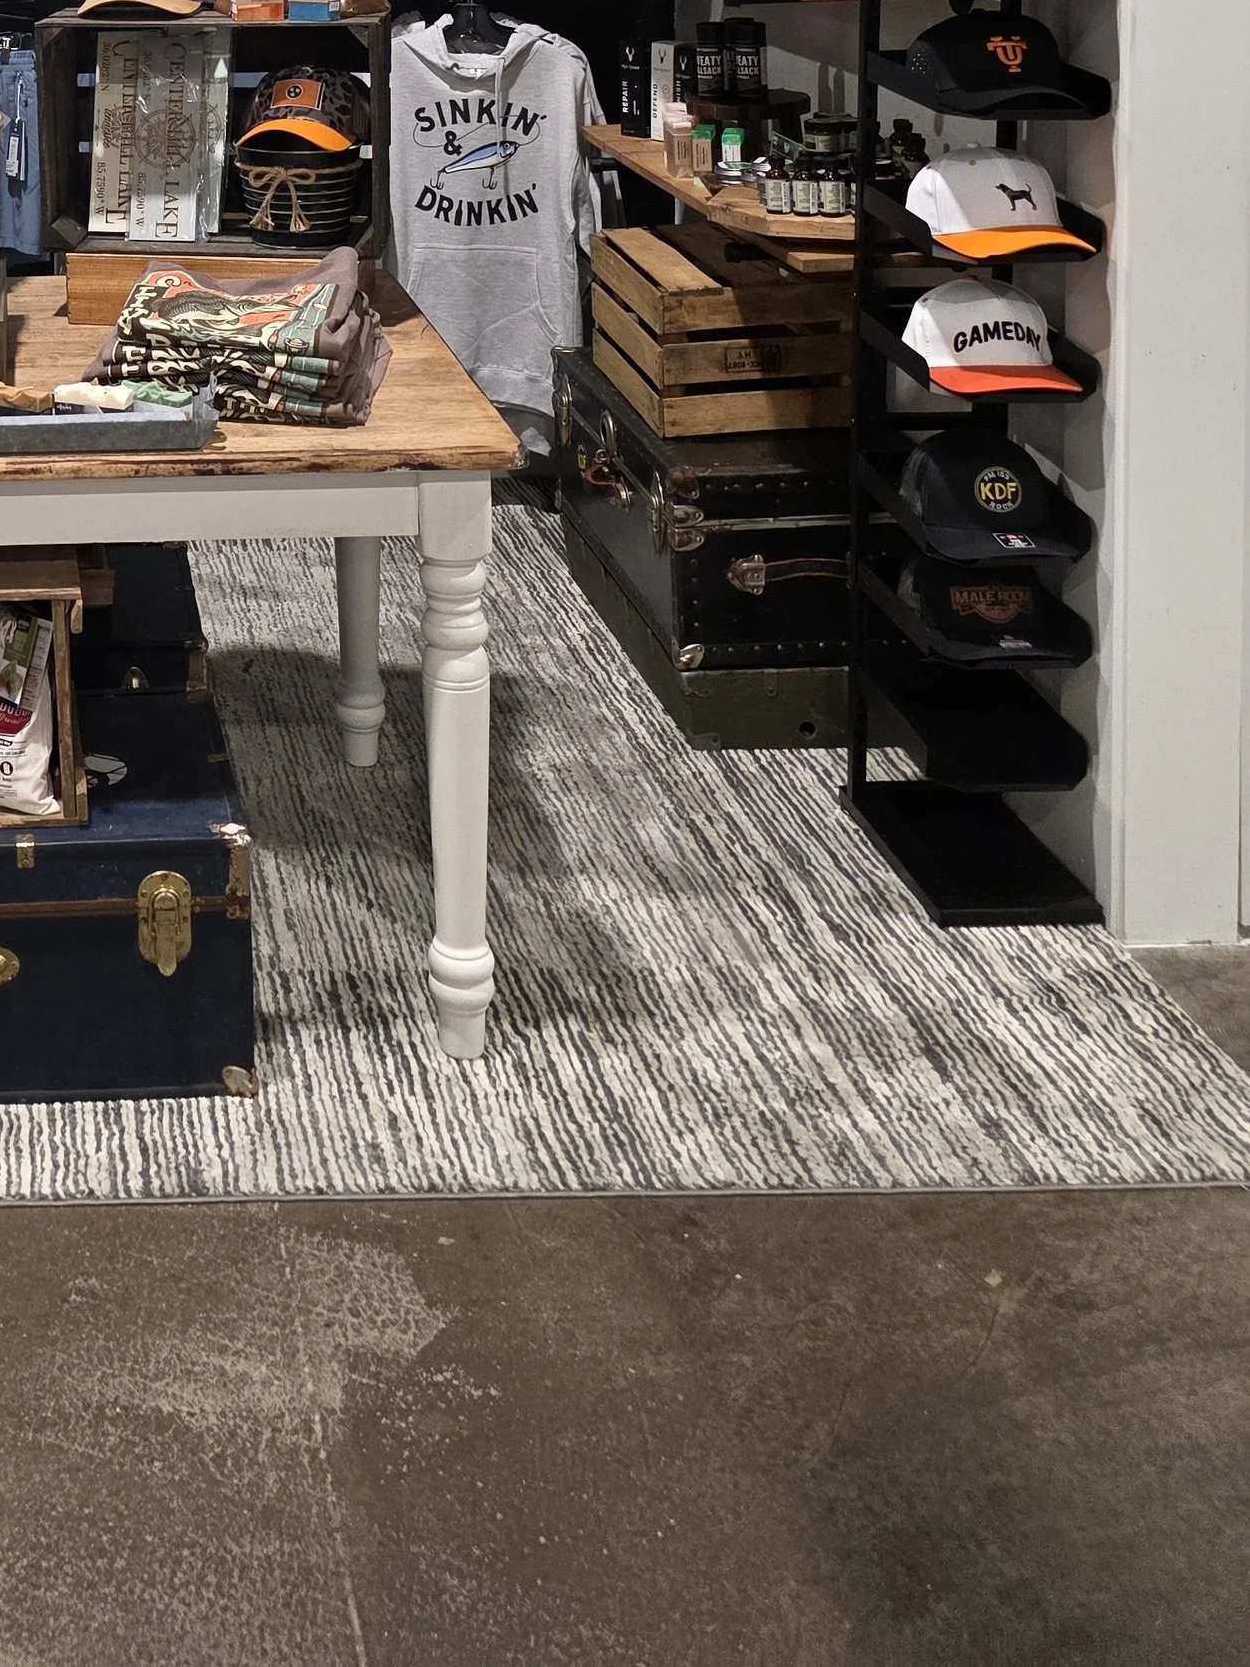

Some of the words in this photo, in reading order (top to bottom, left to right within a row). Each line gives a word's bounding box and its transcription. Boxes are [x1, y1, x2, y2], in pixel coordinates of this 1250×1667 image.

[164, 41, 187, 125] CENTER
[414, 98, 548, 136] SINKIN'
[443, 130, 463, 156] &
[155, 180, 181, 239] LAKE
[414, 182, 539, 227] DRINKIN'
[953, 320, 1041, 353] GAMEDAY
[980, 482, 1017, 501] KDF
[954, 589, 997, 604] MALE
